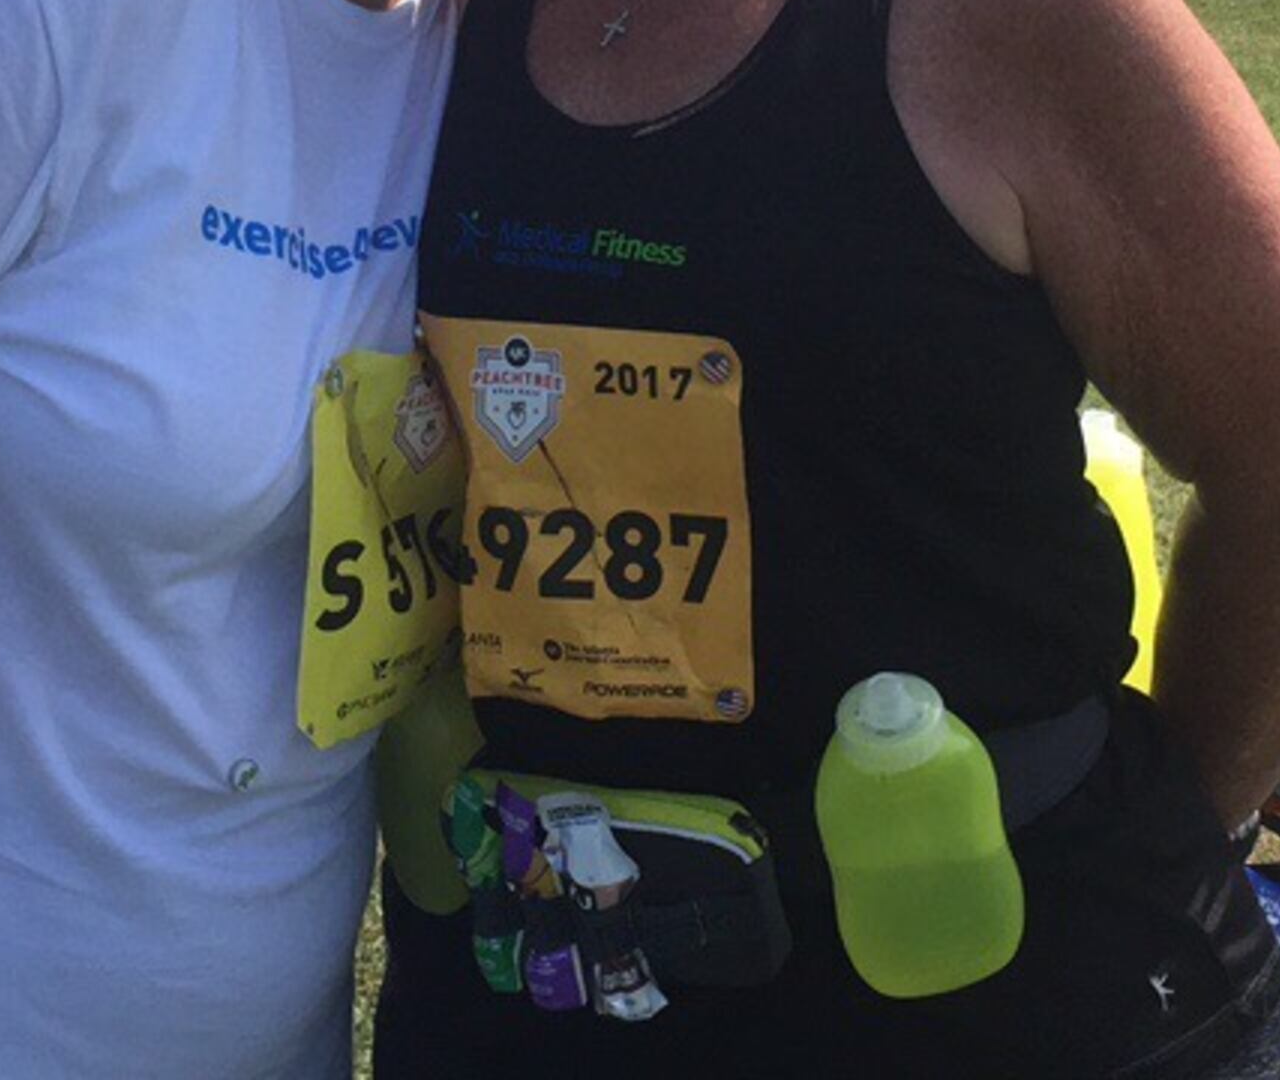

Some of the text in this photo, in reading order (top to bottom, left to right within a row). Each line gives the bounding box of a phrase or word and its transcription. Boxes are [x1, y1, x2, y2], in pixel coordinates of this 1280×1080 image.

[592, 228, 687, 266] Fitness
[473, 371, 563, 392] PEACHTREE
[594, 361, 693, 401] 2017
[462, 506, 729, 604] 9287
[315, 539, 365, 631] S
[583, 681, 689, 699] POWERADE
